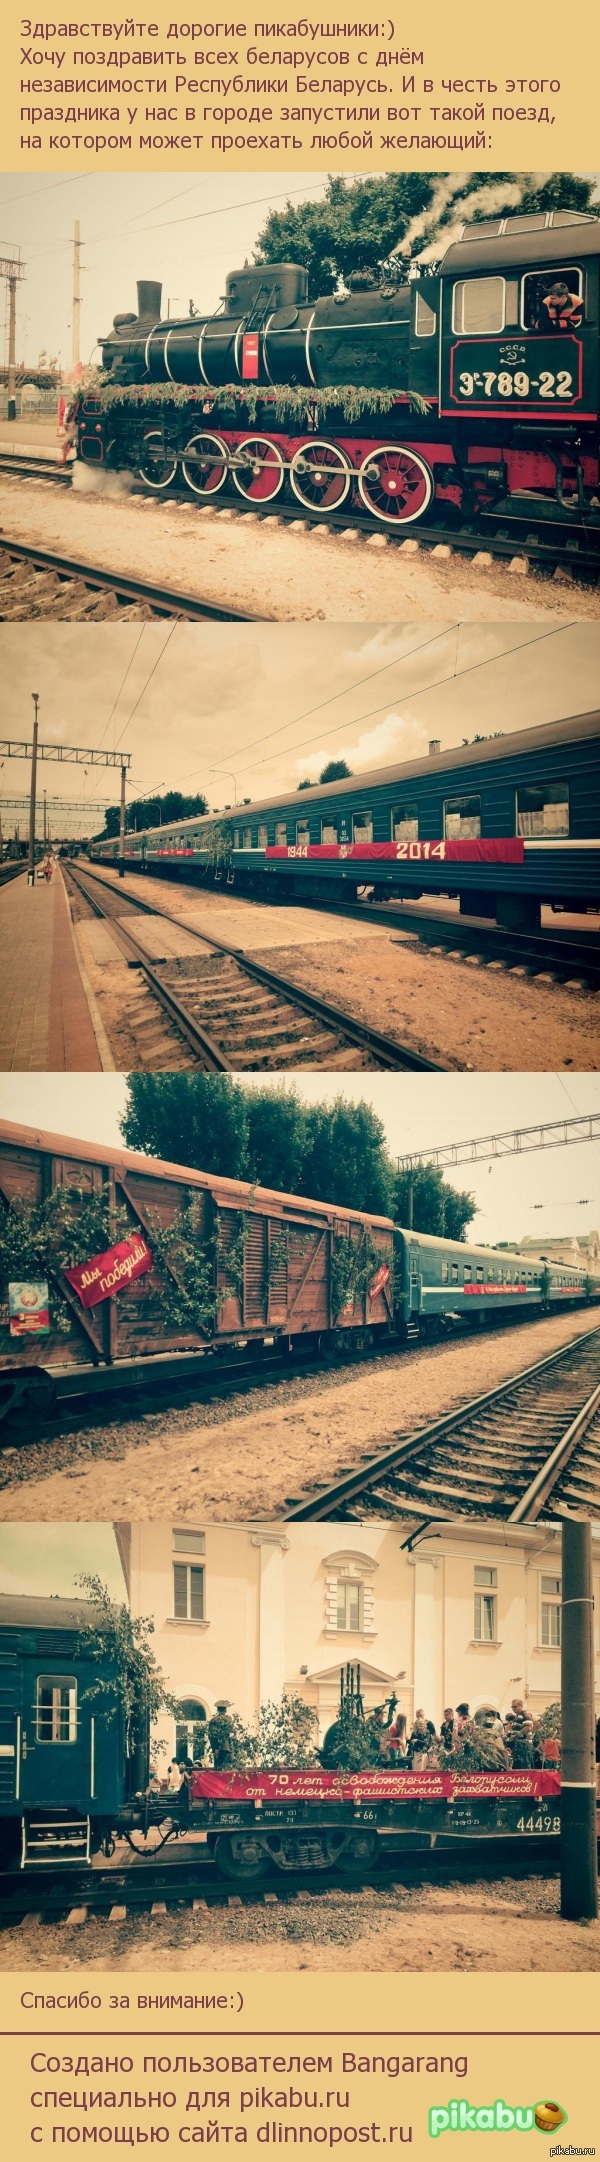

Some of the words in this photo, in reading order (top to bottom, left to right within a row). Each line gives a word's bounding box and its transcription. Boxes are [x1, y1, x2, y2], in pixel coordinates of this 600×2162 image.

[287, 845, 308, 858] 1944
[396, 841, 446, 860] 2014
[99, 1240, 148, 1292] победили!
[81, 1267, 102, 1289] Мы
[268, 1774, 289, 1785] 70
[292, 1777, 323, 1786] лет
[332, 1773, 443, 1787] освобождения
[450, 1773, 532, 1788] Белоруссии
[245, 1787, 267, 1796] от
